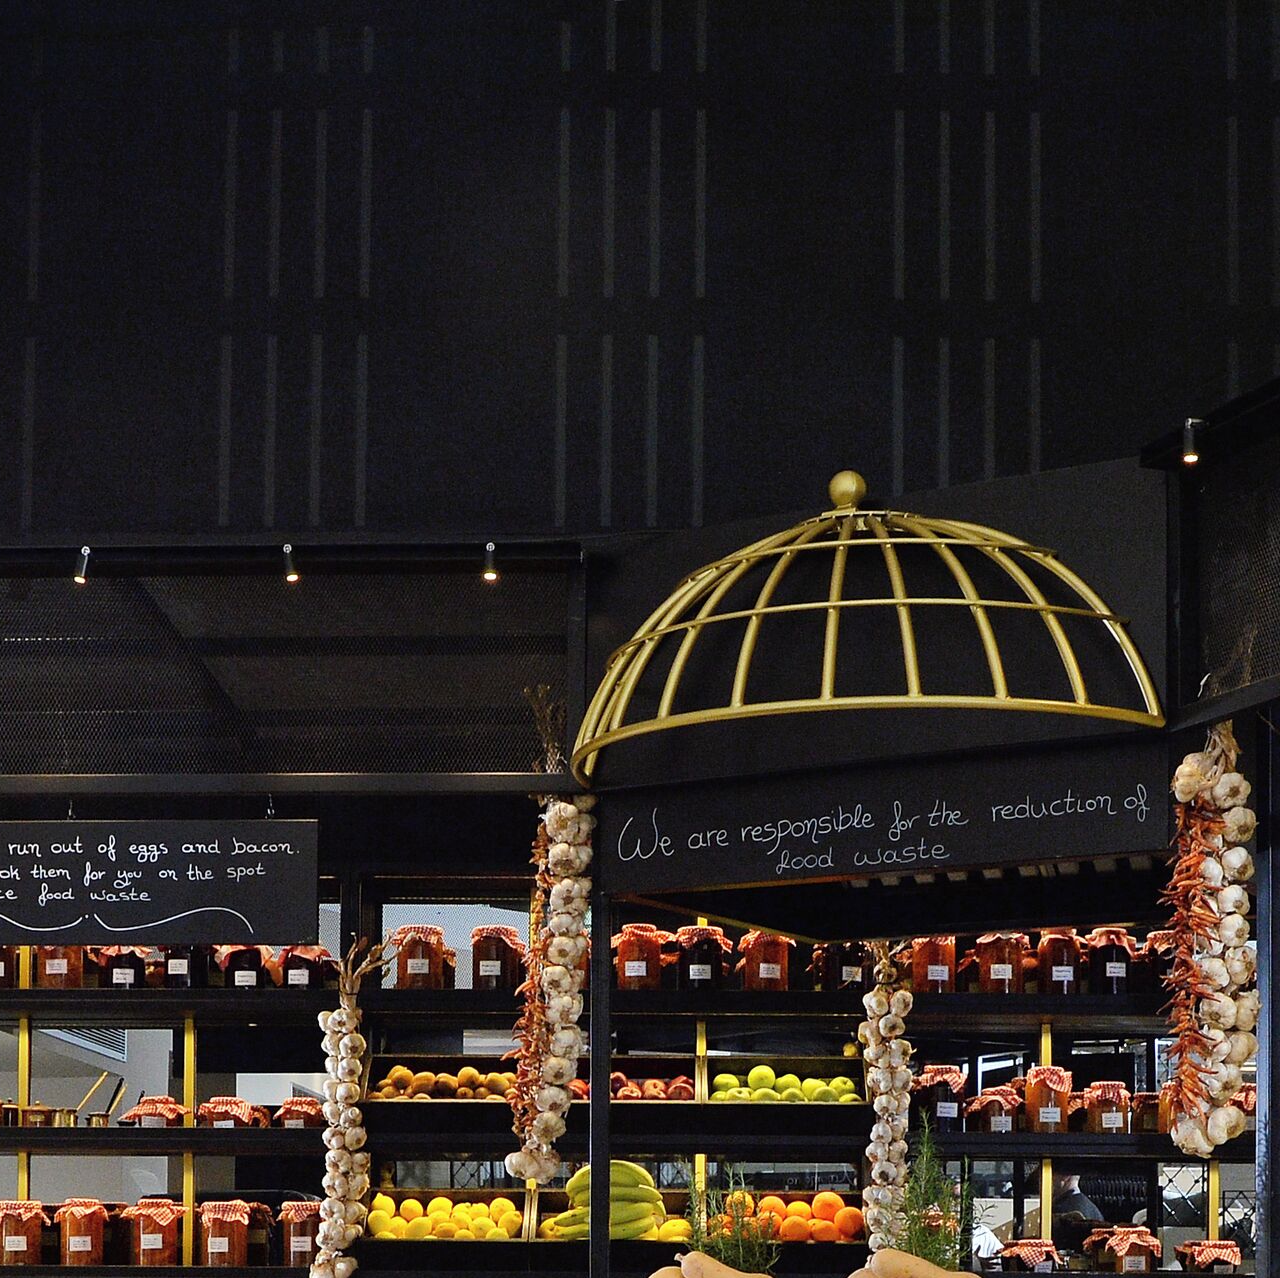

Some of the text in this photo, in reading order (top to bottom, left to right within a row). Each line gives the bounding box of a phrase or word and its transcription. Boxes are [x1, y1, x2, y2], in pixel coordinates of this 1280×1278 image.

[618, 783, 1151, 861] We are responsible for the reduction of
[8, 841, 42, 858] run
[50, 835, 83, 854] out
[97, 834, 116, 861] of
[129, 842, 168, 863] eggs
[181, 838, 221, 854] and
[231, 836, 300, 855] bacon.
[775, 837, 950, 874] food waste
[30, 864, 71, 880] them
[83, 861, 106, 887] for
[113, 869, 142, 889] you
[158, 869, 178, 881] on
[186, 863, 214, 881] the
[226, 862, 267, 882] spot
[38, 882, 75, 906] food
[90, 887, 151, 902] waste
